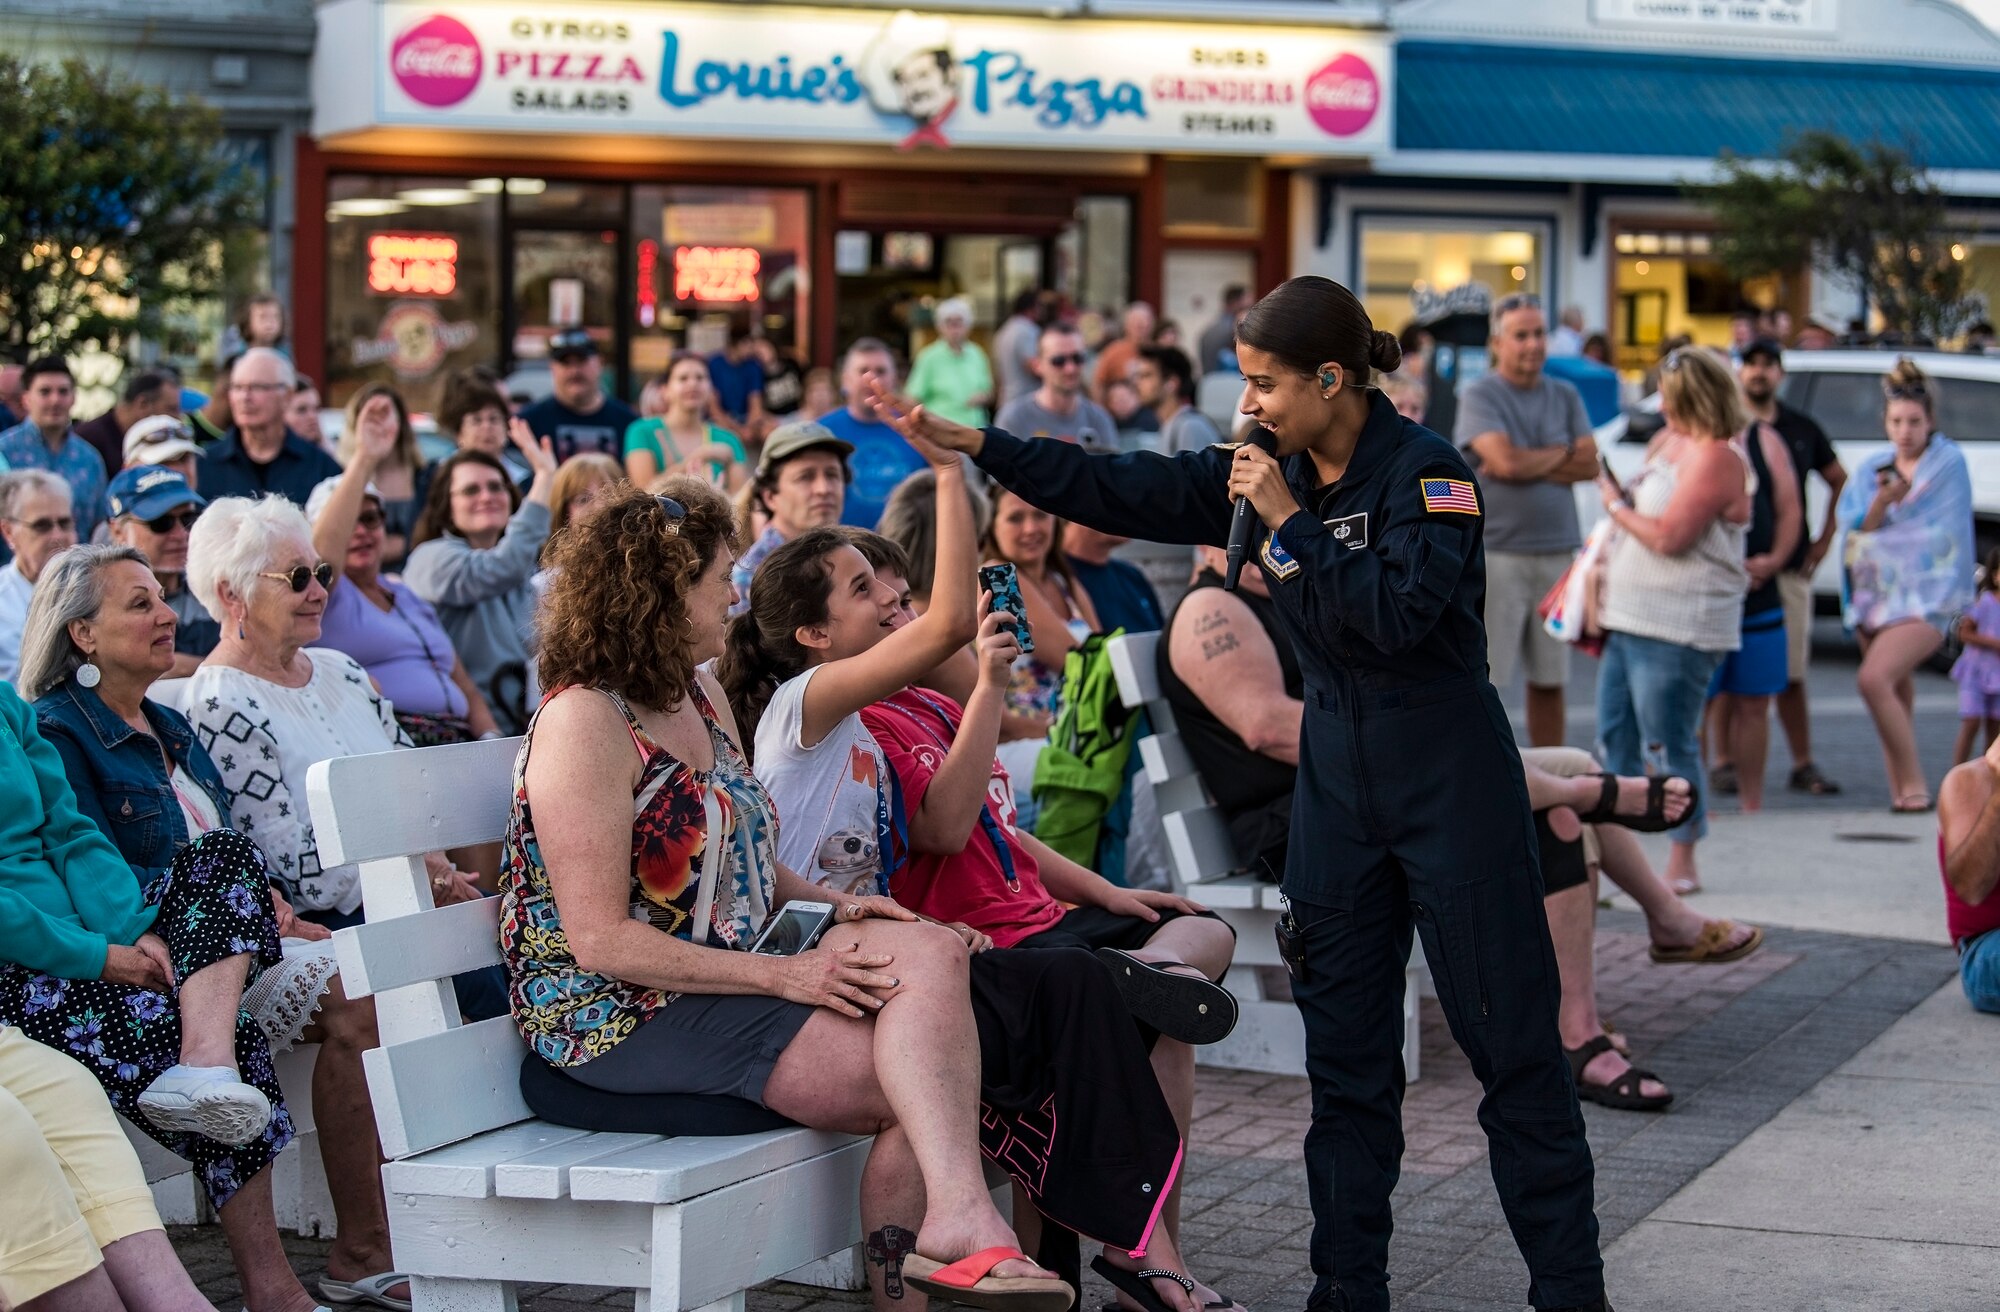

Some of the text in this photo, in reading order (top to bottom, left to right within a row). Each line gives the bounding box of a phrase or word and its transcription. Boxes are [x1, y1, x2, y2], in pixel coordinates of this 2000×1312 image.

[512, 18, 630, 39] GYROS
[496, 52, 645, 83] PIZZA
[658, 30, 1148, 129] Louie's Pizza
[512, 87, 632, 112] SALADS
[1184, 113, 1275, 133] STEAKS
